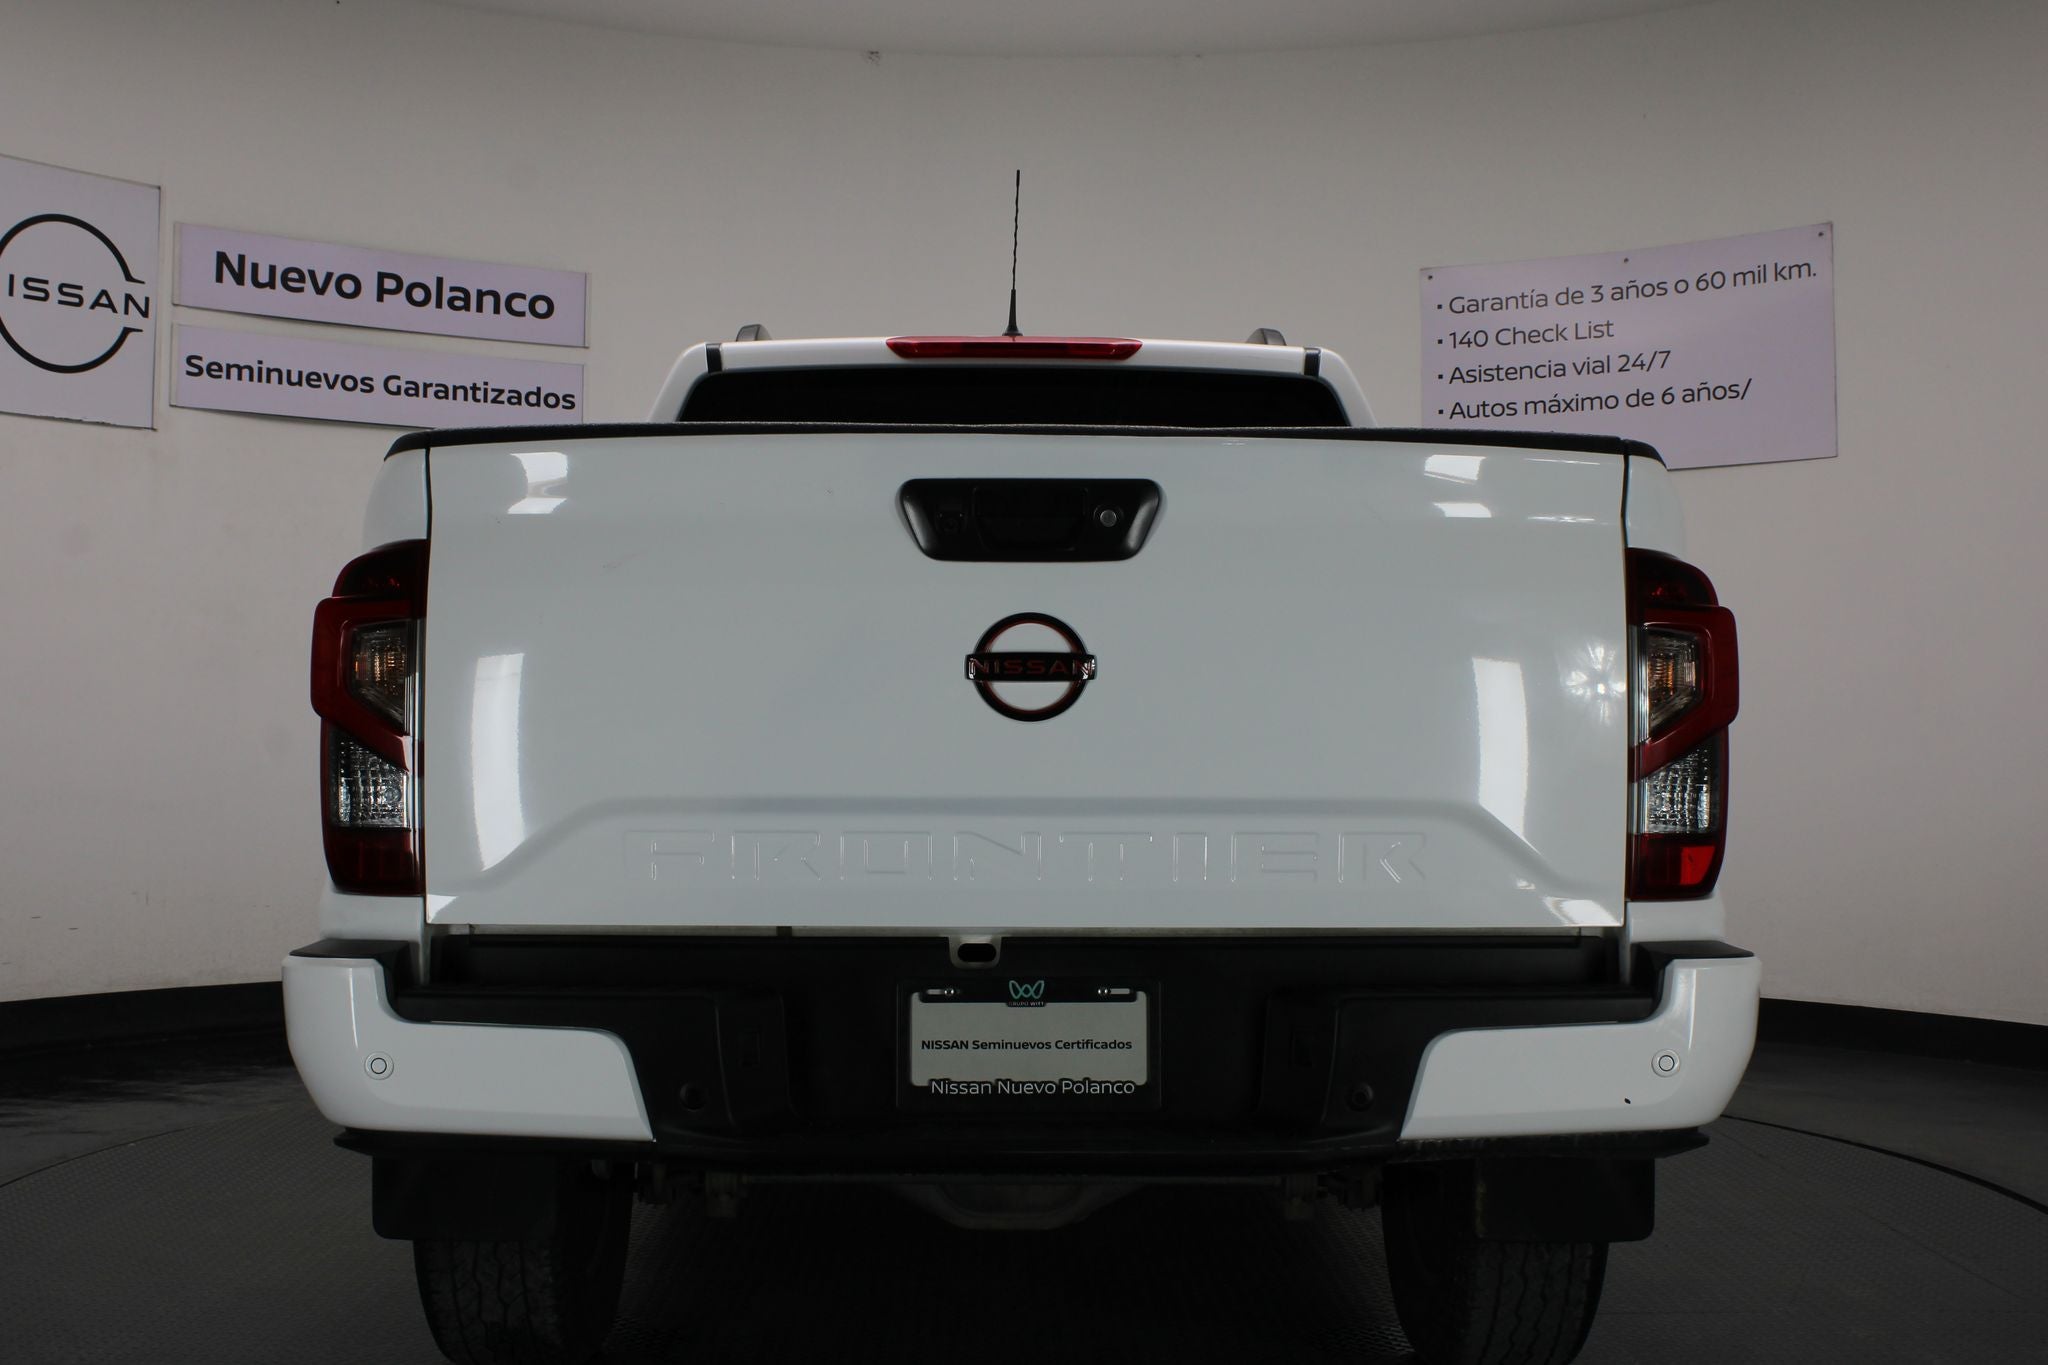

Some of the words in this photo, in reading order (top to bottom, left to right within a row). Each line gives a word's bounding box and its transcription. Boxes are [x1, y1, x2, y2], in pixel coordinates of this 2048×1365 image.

[8, 273, 150, 319] ISSAN
[214, 251, 363, 300] Nuevo
[376, 271, 555, 320] Polanco
[1448, 288, 1549, 316] Garantía
[1555, 285, 1585, 307] de
[1590, 283, 1605, 304] 3
[1610, 277, 1669, 302] años
[1673, 278, 1690, 295] o
[1695, 270, 1727, 292] 60
[1732, 263, 1768, 289] mil
[1773, 259, 1817, 284] km.
[1448, 329, 1489, 350] 140
[1495, 322, 1569, 348] Check
[1574, 319, 1615, 341] List
[184, 353, 375, 396] Seminuevos
[382, 373, 577, 411] Garantizados
[1448, 357, 1567, 385] Asistencia
[1572, 353, 1612, 376] vial
[1617, 349, 1672, 374] 24/7
[1448, 396, 1518, 420] Autos
[1523, 389, 1620, 415] máximo
[1625, 384, 1656, 408] de
[1660, 384, 1676, 405] 6
[1681, 377, 1753, 403] años/
[968, 657, 1095, 678] NISSAN
[623, 829, 1428, 883] FRONTIER
[921, 1039, 969, 1050] NISSAN
[971, 1039, 1052, 1050] Seminuevos
[1054, 1038, 1133, 1050] Certificados
[930, 1080, 992, 1095] Nissan
[997, 1080, 1057, 1095] Nuevo
[1061, 1079, 1135, 1095] Polanco
